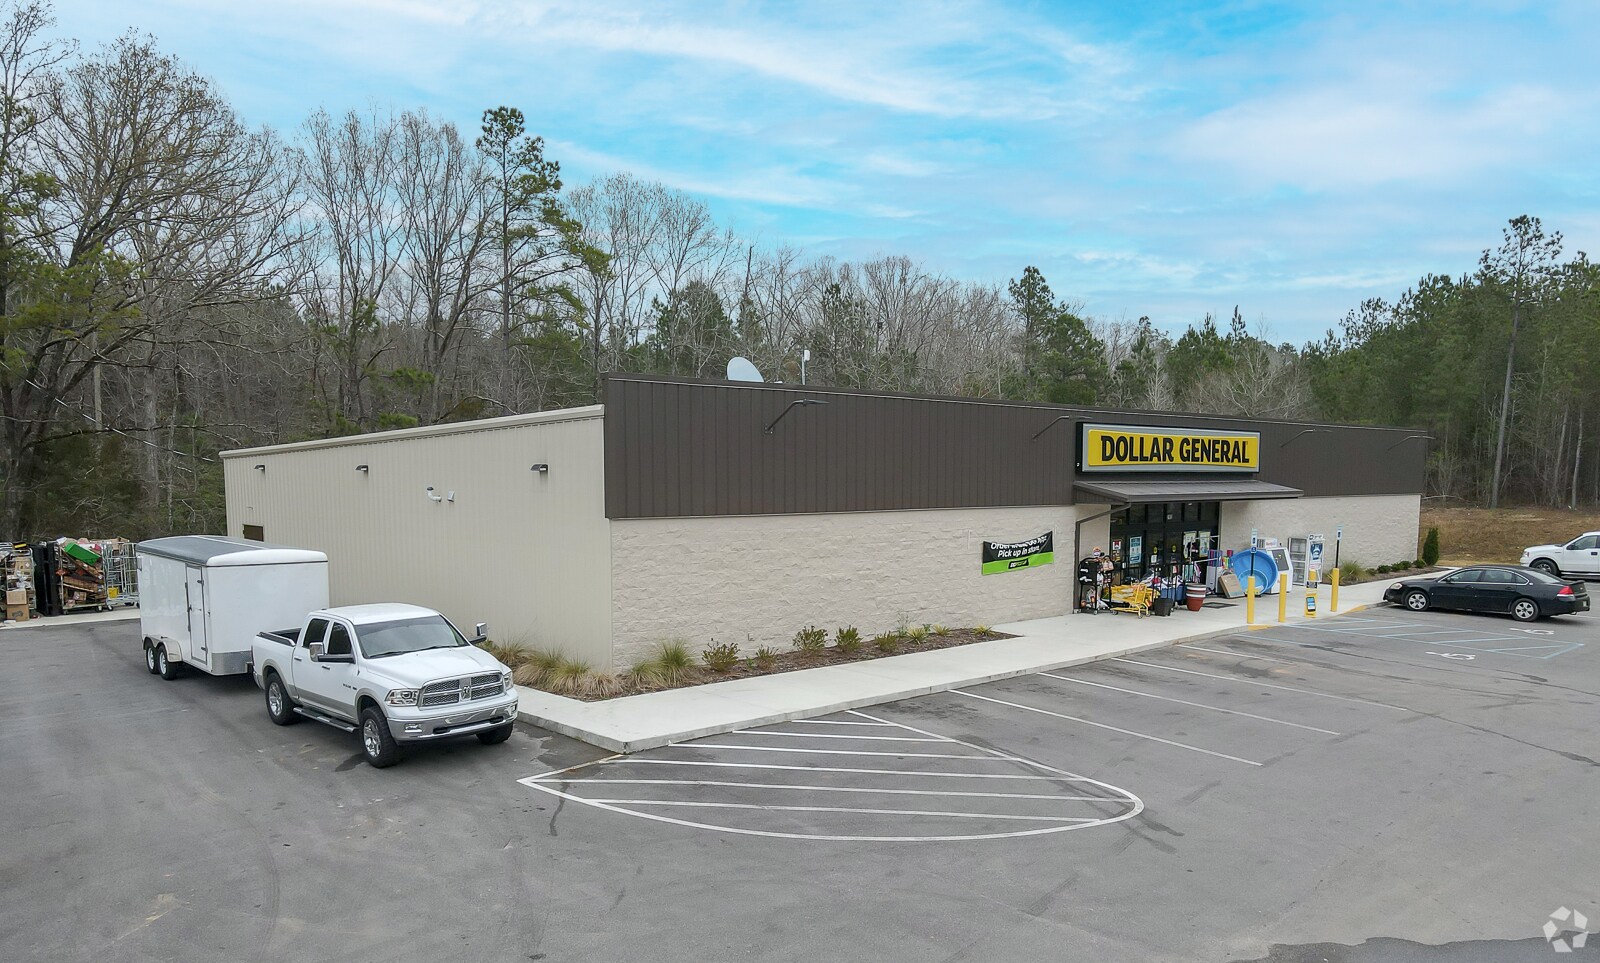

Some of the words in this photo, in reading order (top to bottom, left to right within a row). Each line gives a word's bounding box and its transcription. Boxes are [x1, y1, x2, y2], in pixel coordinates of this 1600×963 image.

[1101, 435, 1174, 462] DOLLAR
[1179, 437, 1250, 464] GENERAL
[997, 550, 1012, 558] Pick
